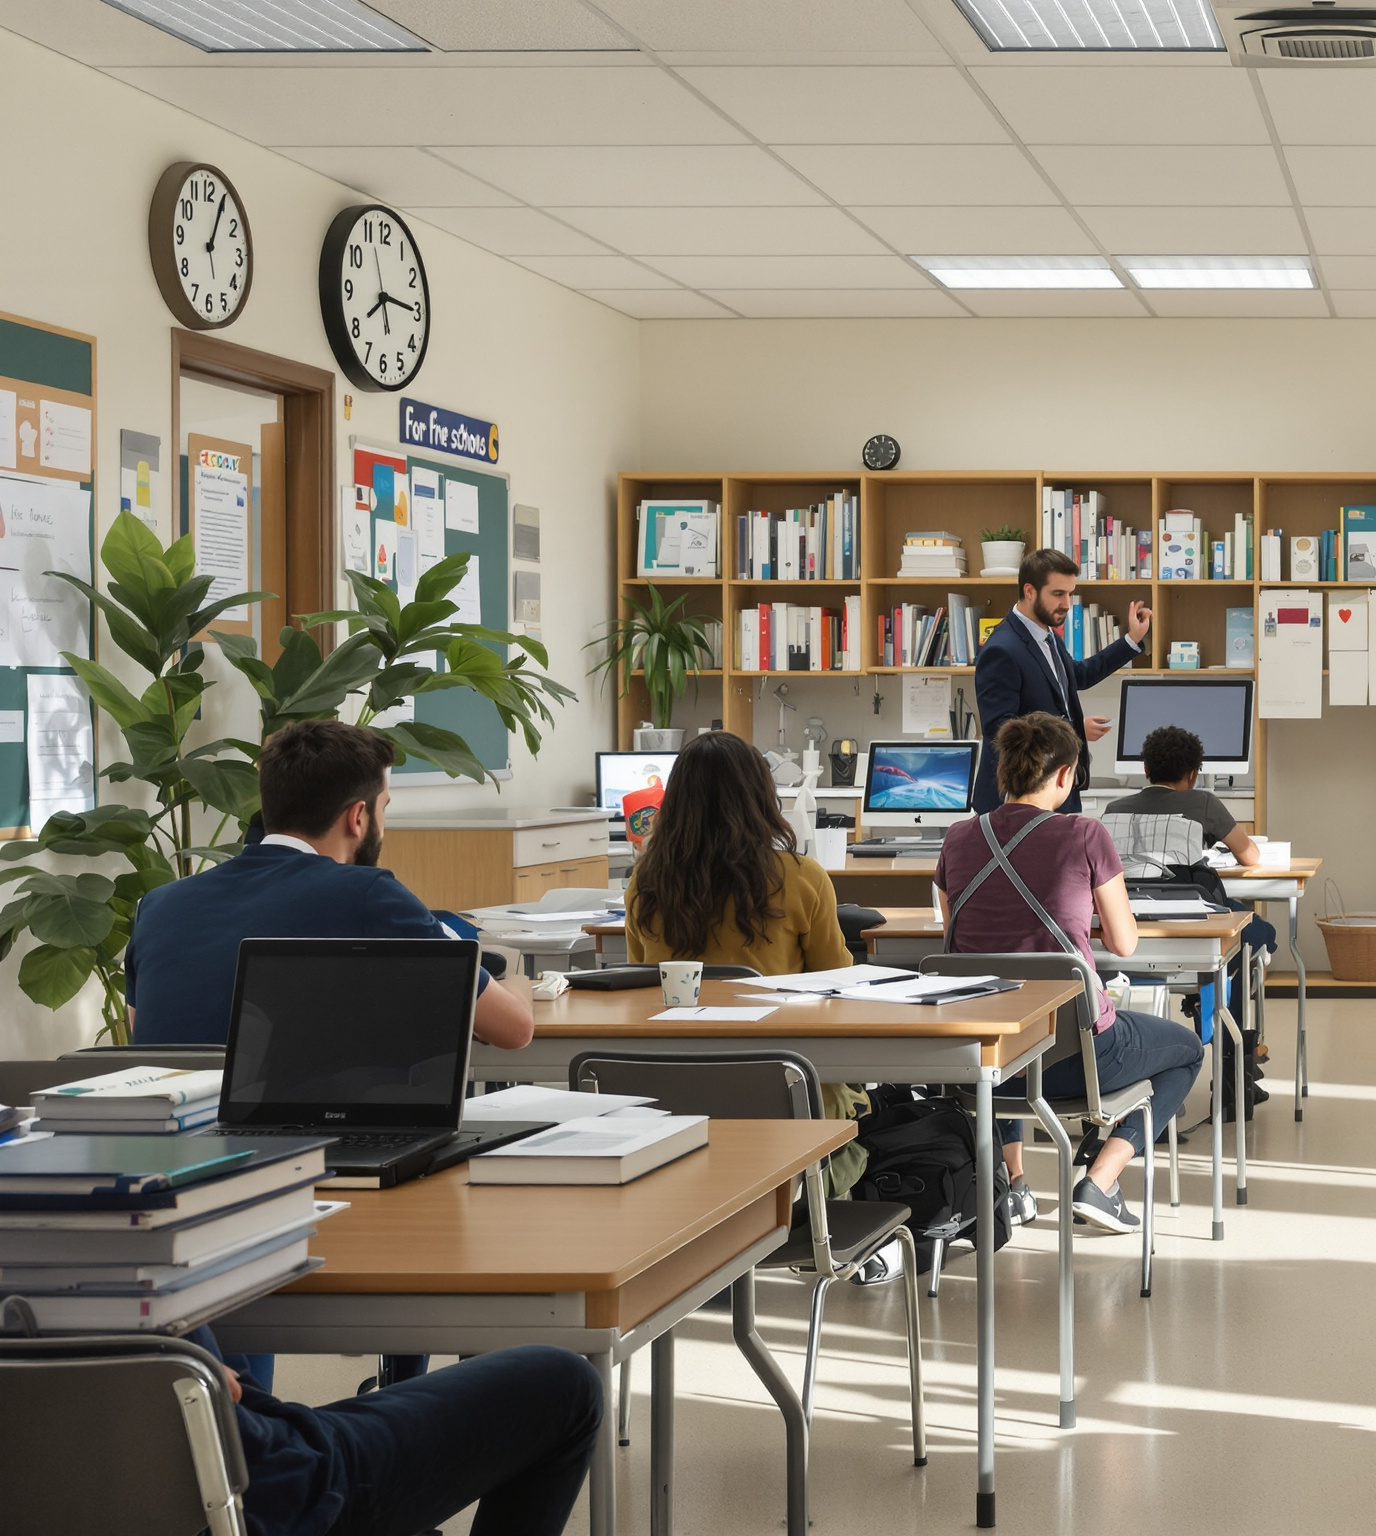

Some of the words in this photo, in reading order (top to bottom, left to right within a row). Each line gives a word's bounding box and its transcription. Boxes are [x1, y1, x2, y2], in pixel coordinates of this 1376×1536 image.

[190, 180, 198, 201] 11
[204, 179, 215, 203] 12
[180, 198, 193, 221] 10
[176, 225, 184, 245] 9
[229, 219, 238, 238] 2
[364, 219, 373, 243] 11
[379, 220, 391, 246] 12
[181, 257, 189, 277] 8
[235, 248, 243, 267] 3
[350, 244, 363, 269] 10
[229, 273, 238, 290] 4
[408, 267, 417, 288] 2
[191, 283, 199, 302] 7
[344, 279, 354, 301] 9
[205, 293, 213, 313] 6
[220, 292, 227, 313] 5
[413, 301, 422, 322] 3
[352, 317, 360, 339] 8
[365, 341, 373, 365] 7
[407, 333, 417, 352] 4
[379, 353, 387, 374] 6
[396, 351, 404, 371] 5
[405, 405, 427, 442] For
